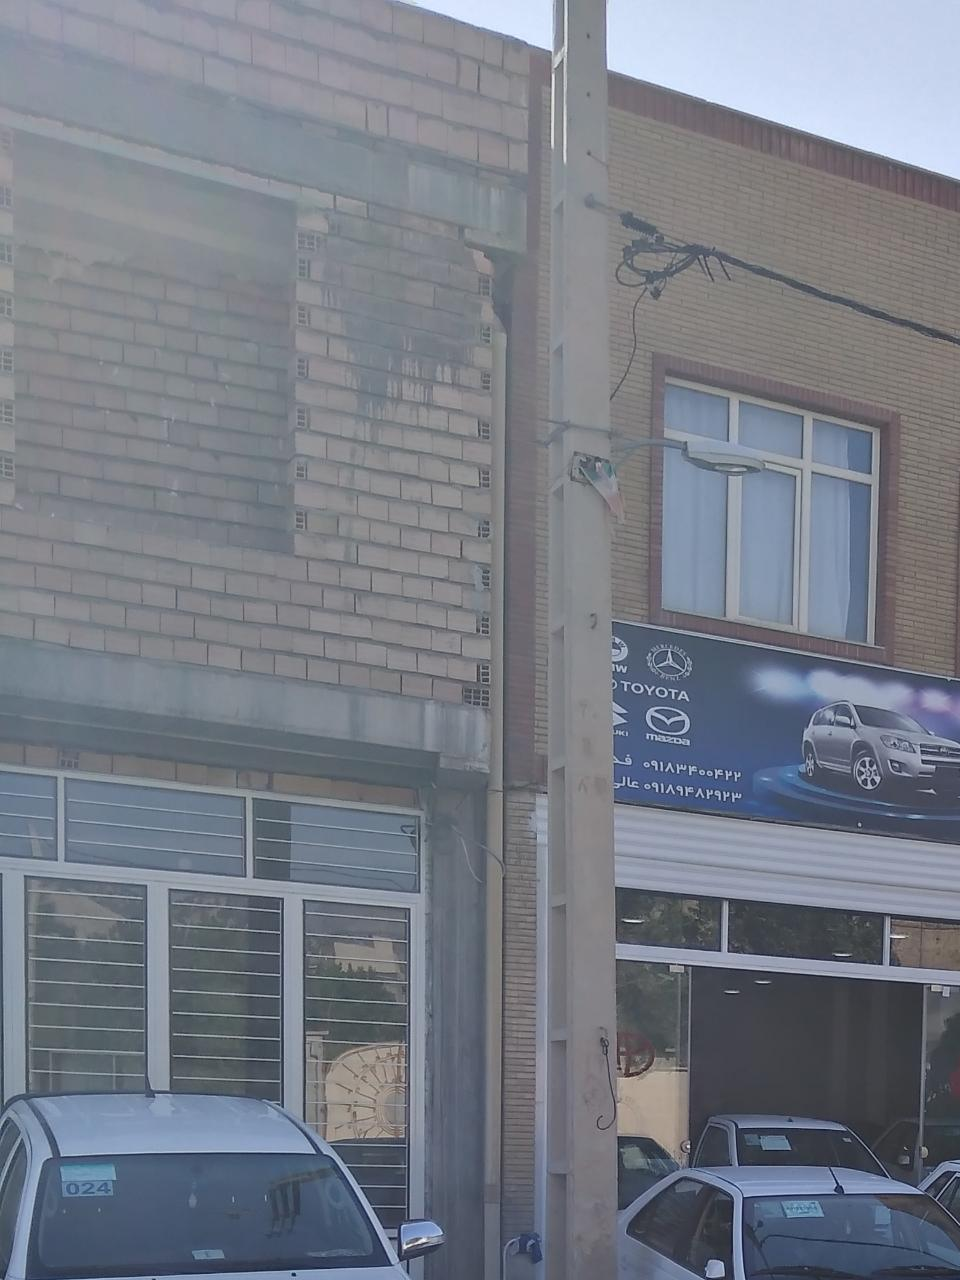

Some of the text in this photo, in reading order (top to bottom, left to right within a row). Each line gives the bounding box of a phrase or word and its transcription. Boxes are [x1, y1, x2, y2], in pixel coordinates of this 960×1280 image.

[620, 680, 690, 702] TOYOTA
[613, 729, 629, 737] UKI
[645, 732, 691, 746] mazda
[643, 759, 742, 783] ۰۹۱۸۳۴۰۰۴۲۲
[65, 1181, 112, 1196] 024
